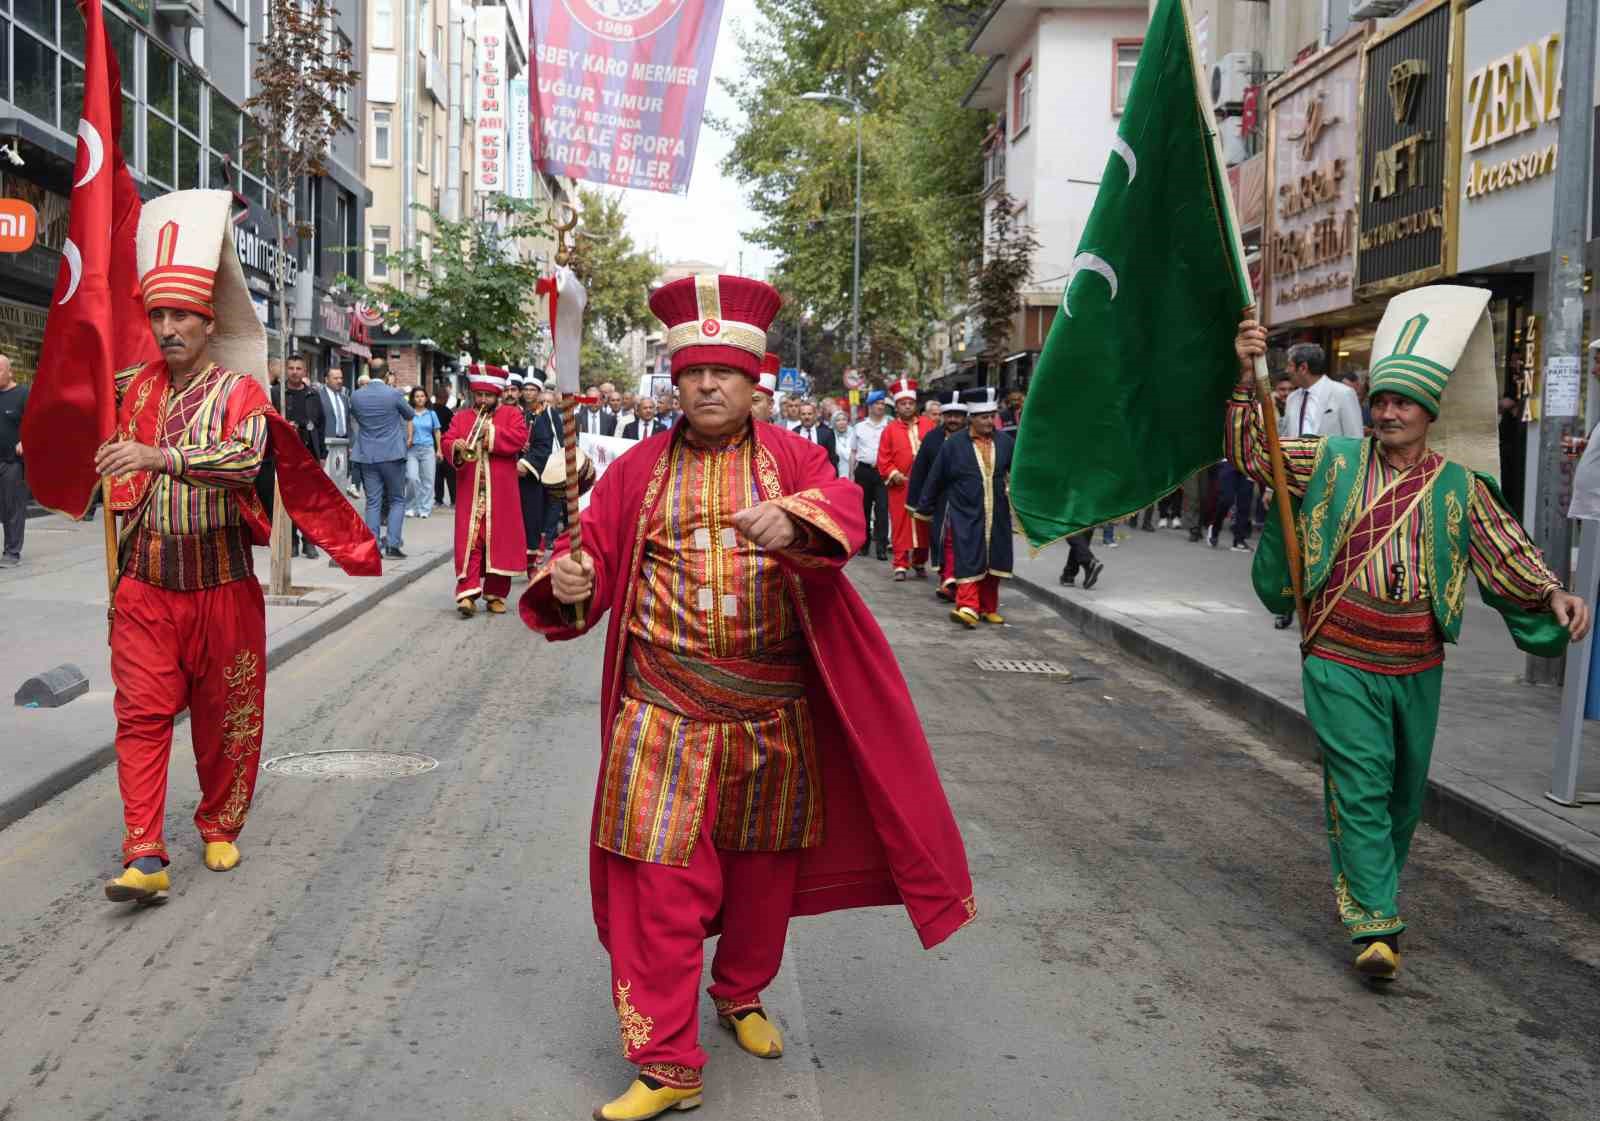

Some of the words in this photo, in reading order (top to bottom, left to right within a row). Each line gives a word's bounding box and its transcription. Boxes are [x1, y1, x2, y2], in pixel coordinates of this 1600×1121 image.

[596, 21, 633, 37] 1989
[535, 44, 580, 69] SBEY
[582, 52, 628, 78] KARO
[632, 63, 699, 86] MERMER
[541, 115, 612, 146] KKALE
[620, 131, 686, 157] SPOR'A
[542, 142, 611, 169] ARILAR
[615, 154, 670, 180] DİLER
[1369, 132, 1425, 202] AFT
[1522, 315, 1536, 422] ZENA
